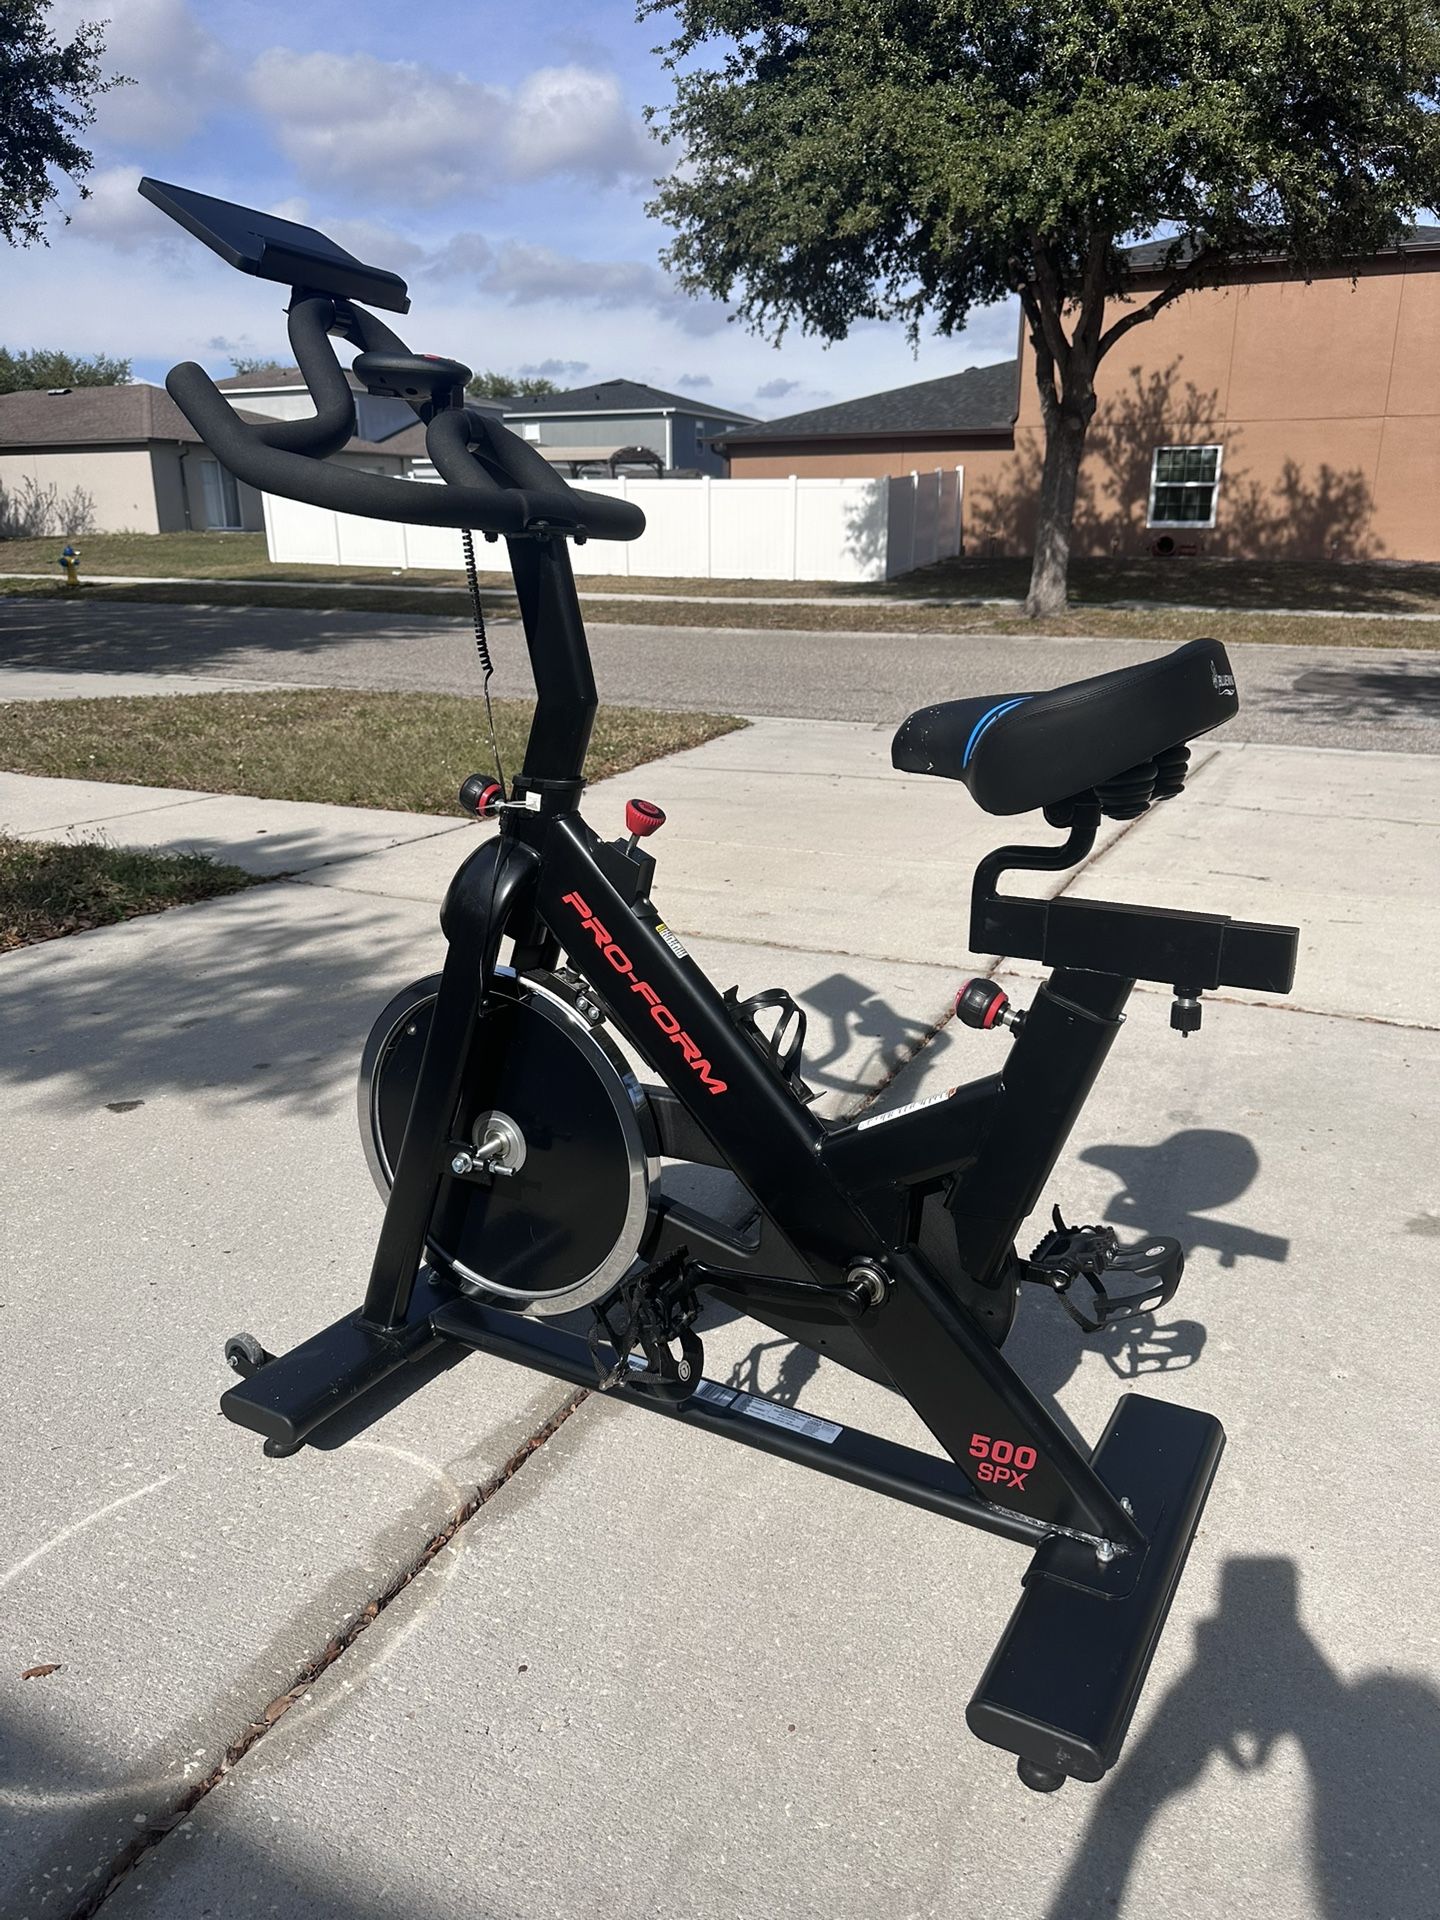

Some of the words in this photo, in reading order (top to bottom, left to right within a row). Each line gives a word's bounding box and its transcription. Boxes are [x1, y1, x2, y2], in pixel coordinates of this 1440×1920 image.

[562, 891, 727, 1095] PRO-FORM
[969, 1434, 1037, 1470] 500
[977, 1462, 1028, 1491] SPX
